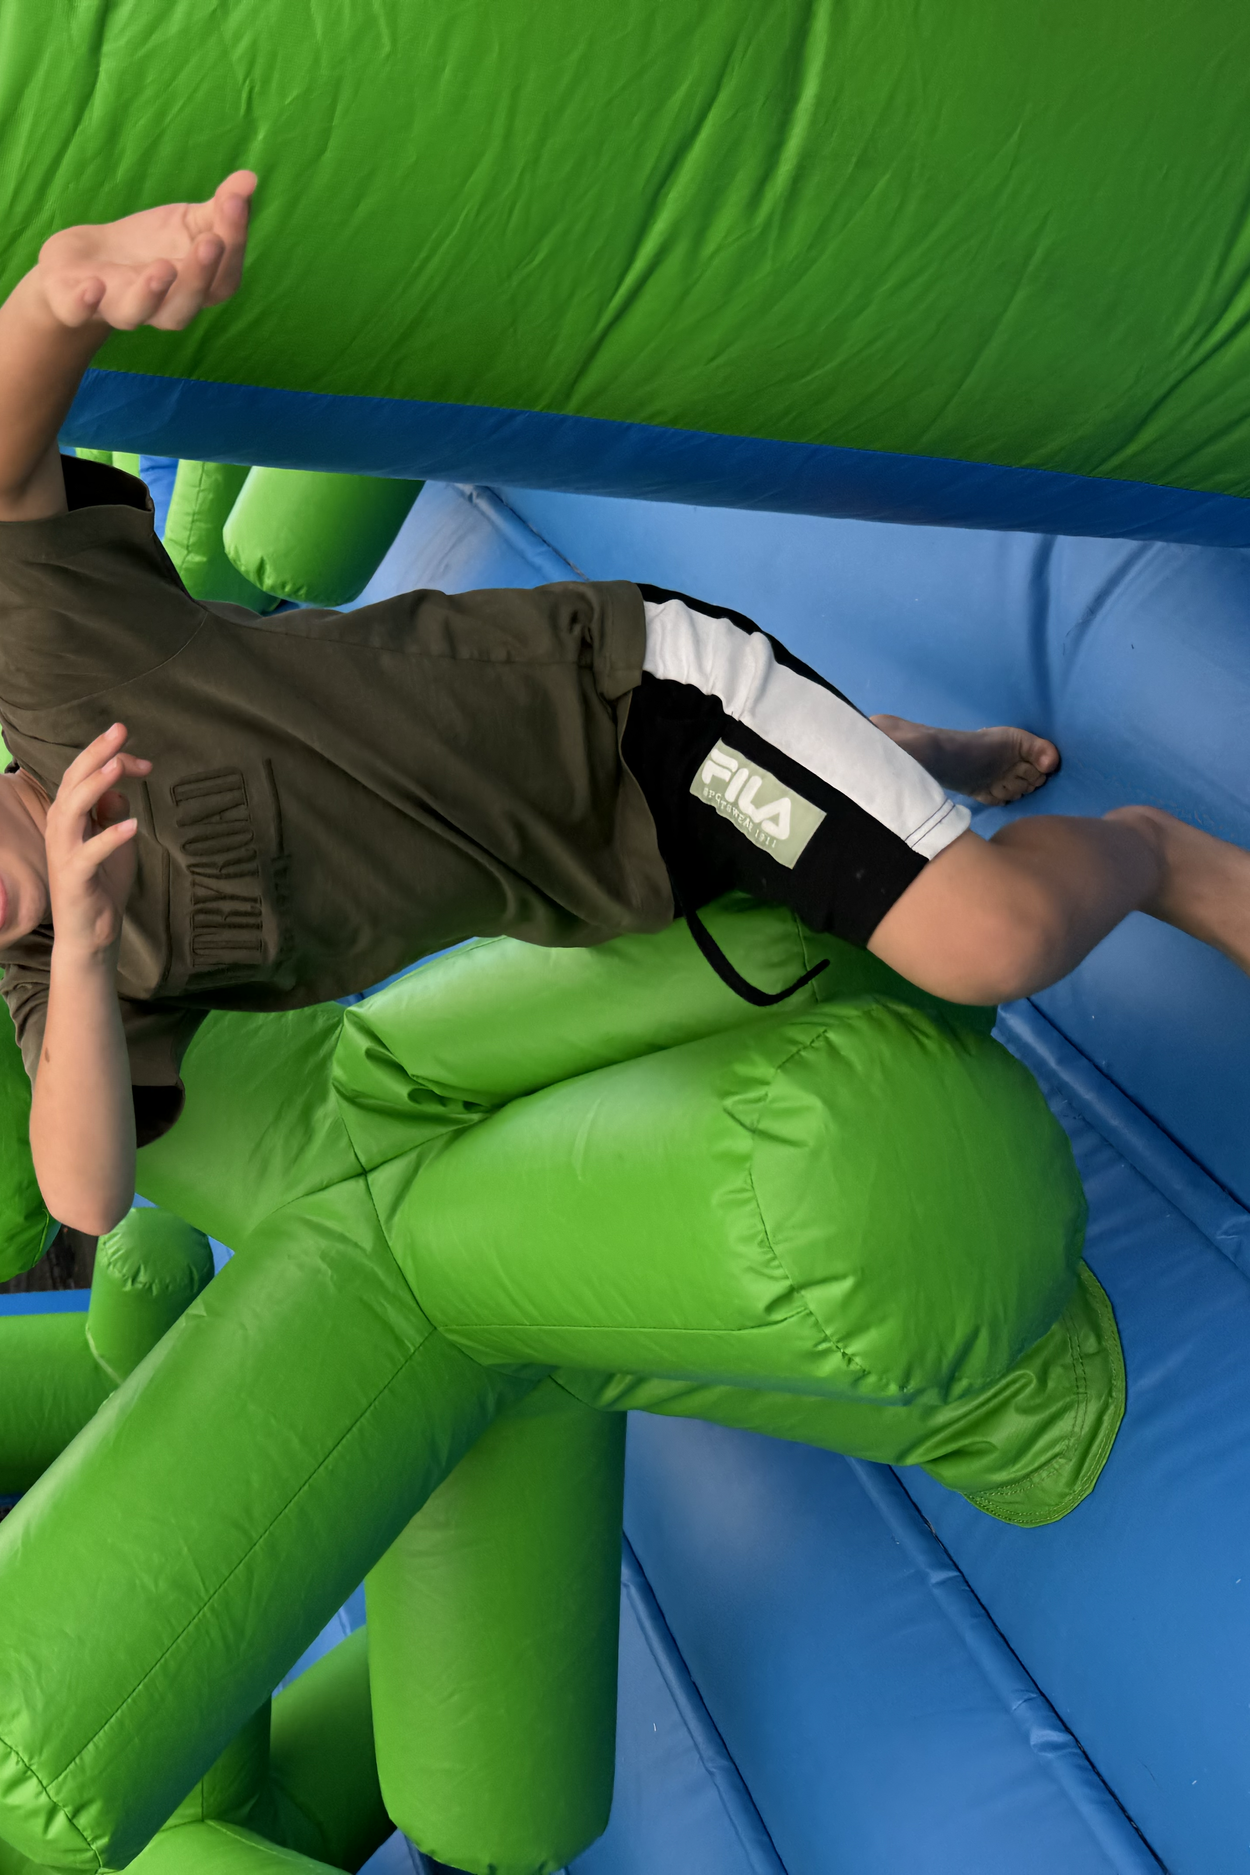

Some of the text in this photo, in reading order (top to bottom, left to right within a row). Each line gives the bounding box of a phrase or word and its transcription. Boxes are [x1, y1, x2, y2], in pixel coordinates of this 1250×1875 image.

[169, 764, 257, 879] ROAD
[701, 748, 792, 840] FILA
[754, 828, 778, 848] 1911
